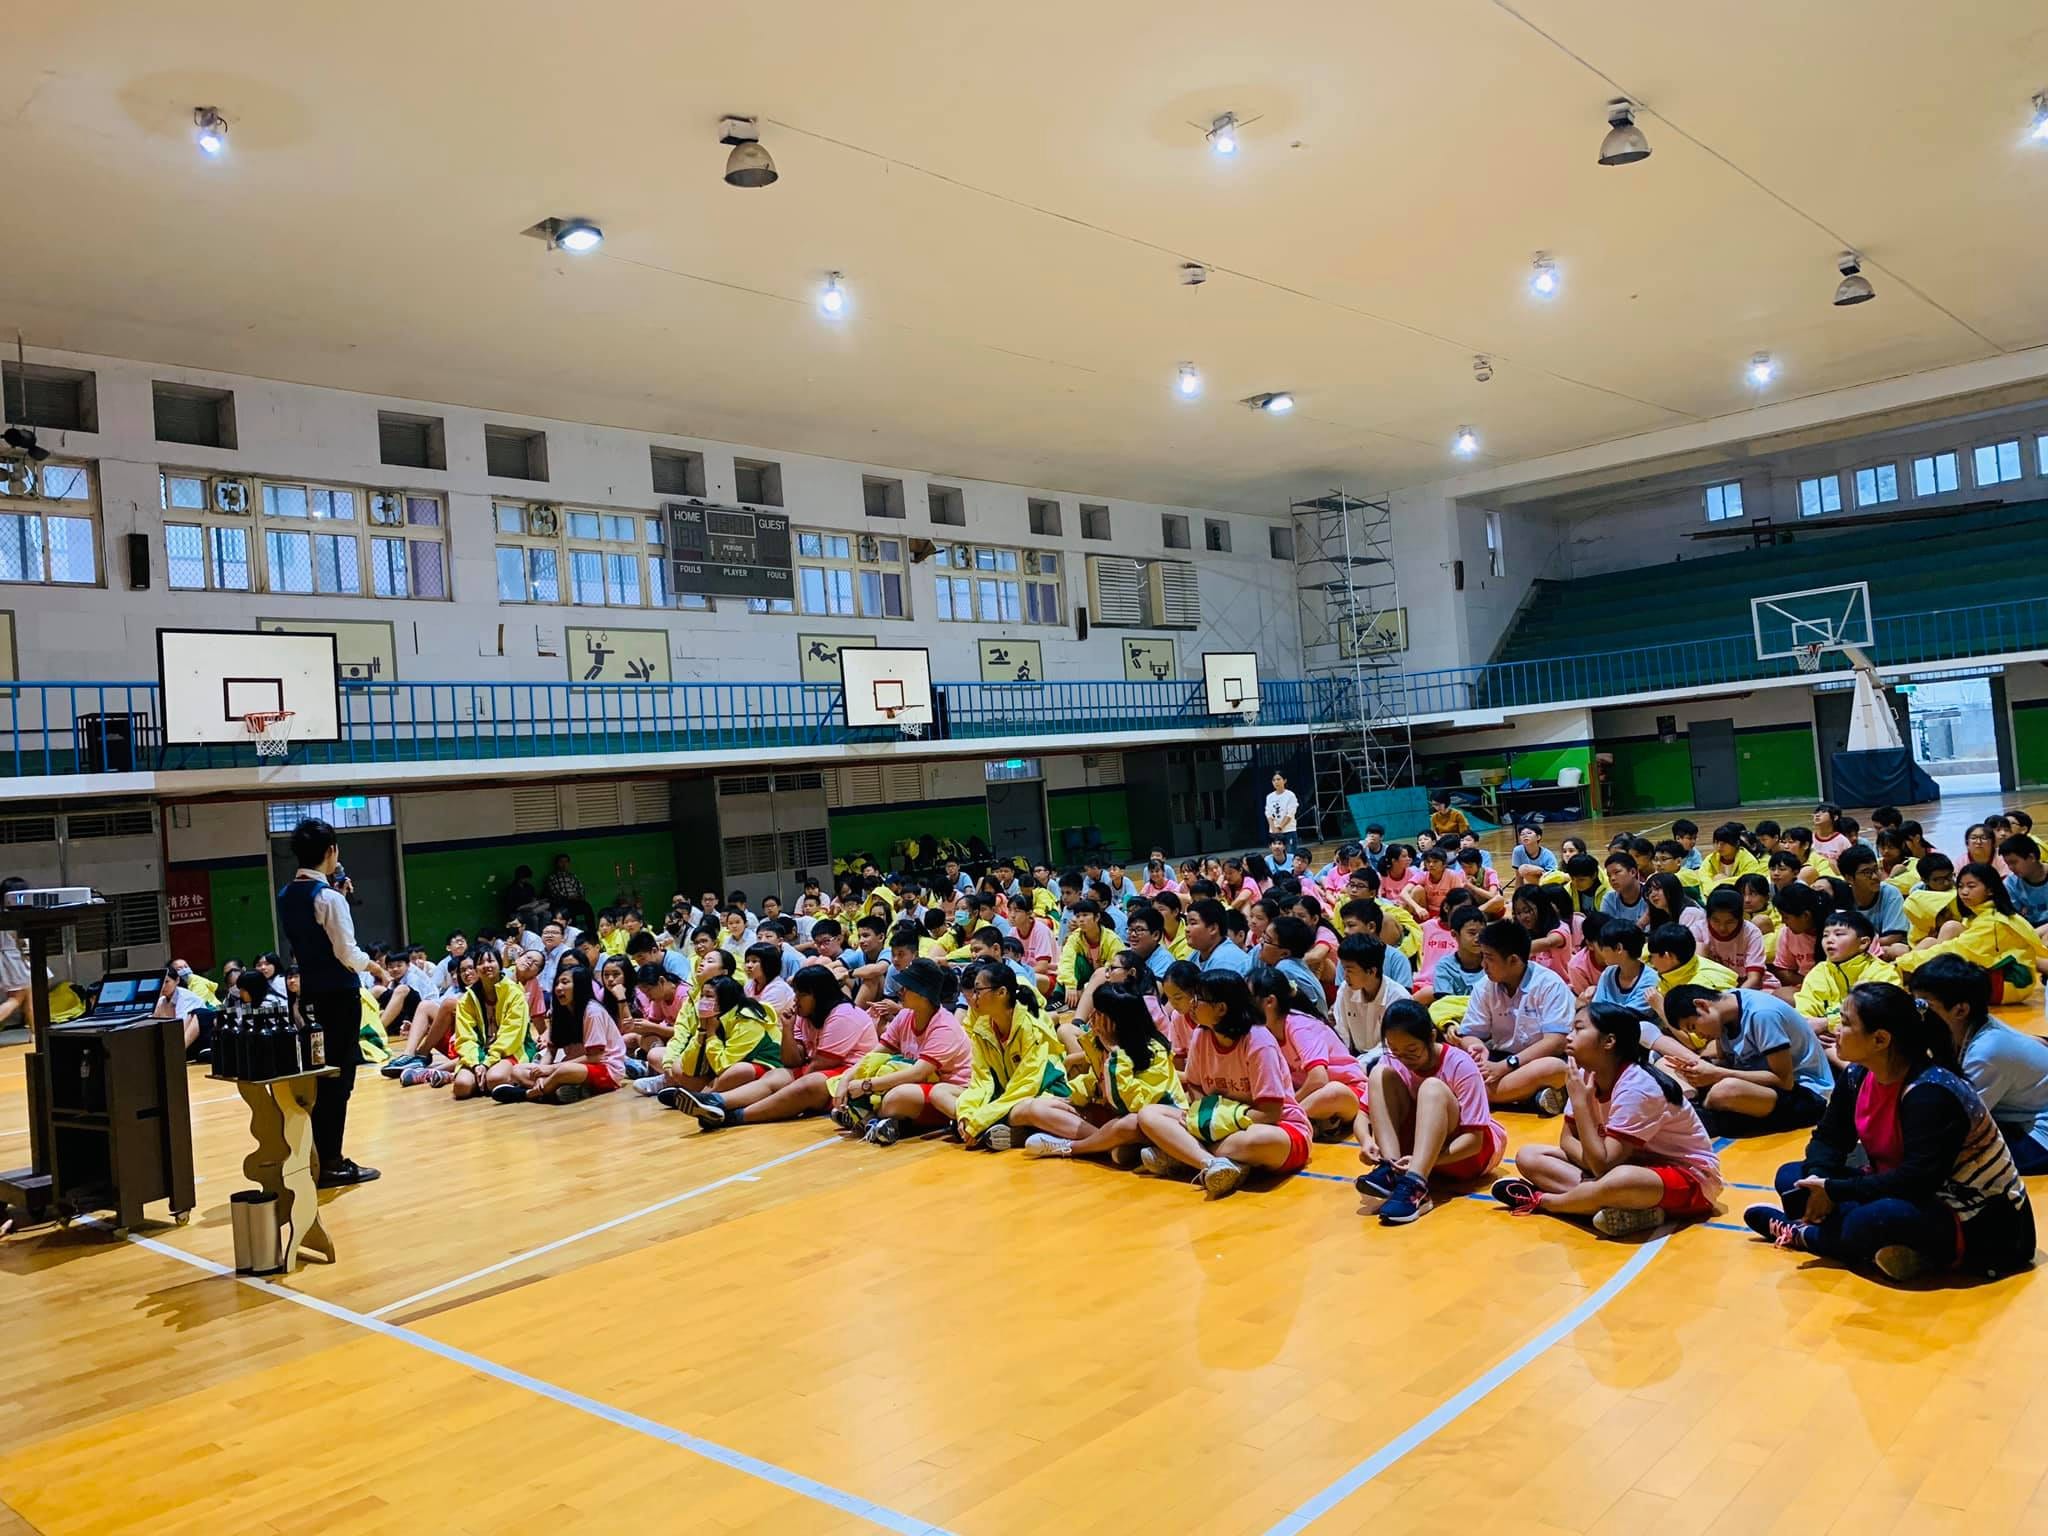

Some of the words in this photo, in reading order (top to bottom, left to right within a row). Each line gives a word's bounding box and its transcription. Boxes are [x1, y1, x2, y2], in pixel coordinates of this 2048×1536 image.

[673, 510, 701, 522] HOME
[758, 519, 785, 530] GUEST
[680, 564, 702, 573] FOULS
[723, 567, 748, 576] PLAYER
[766, 570, 788, 580] FOULS
[167, 894, 204, 909] 消防栓
